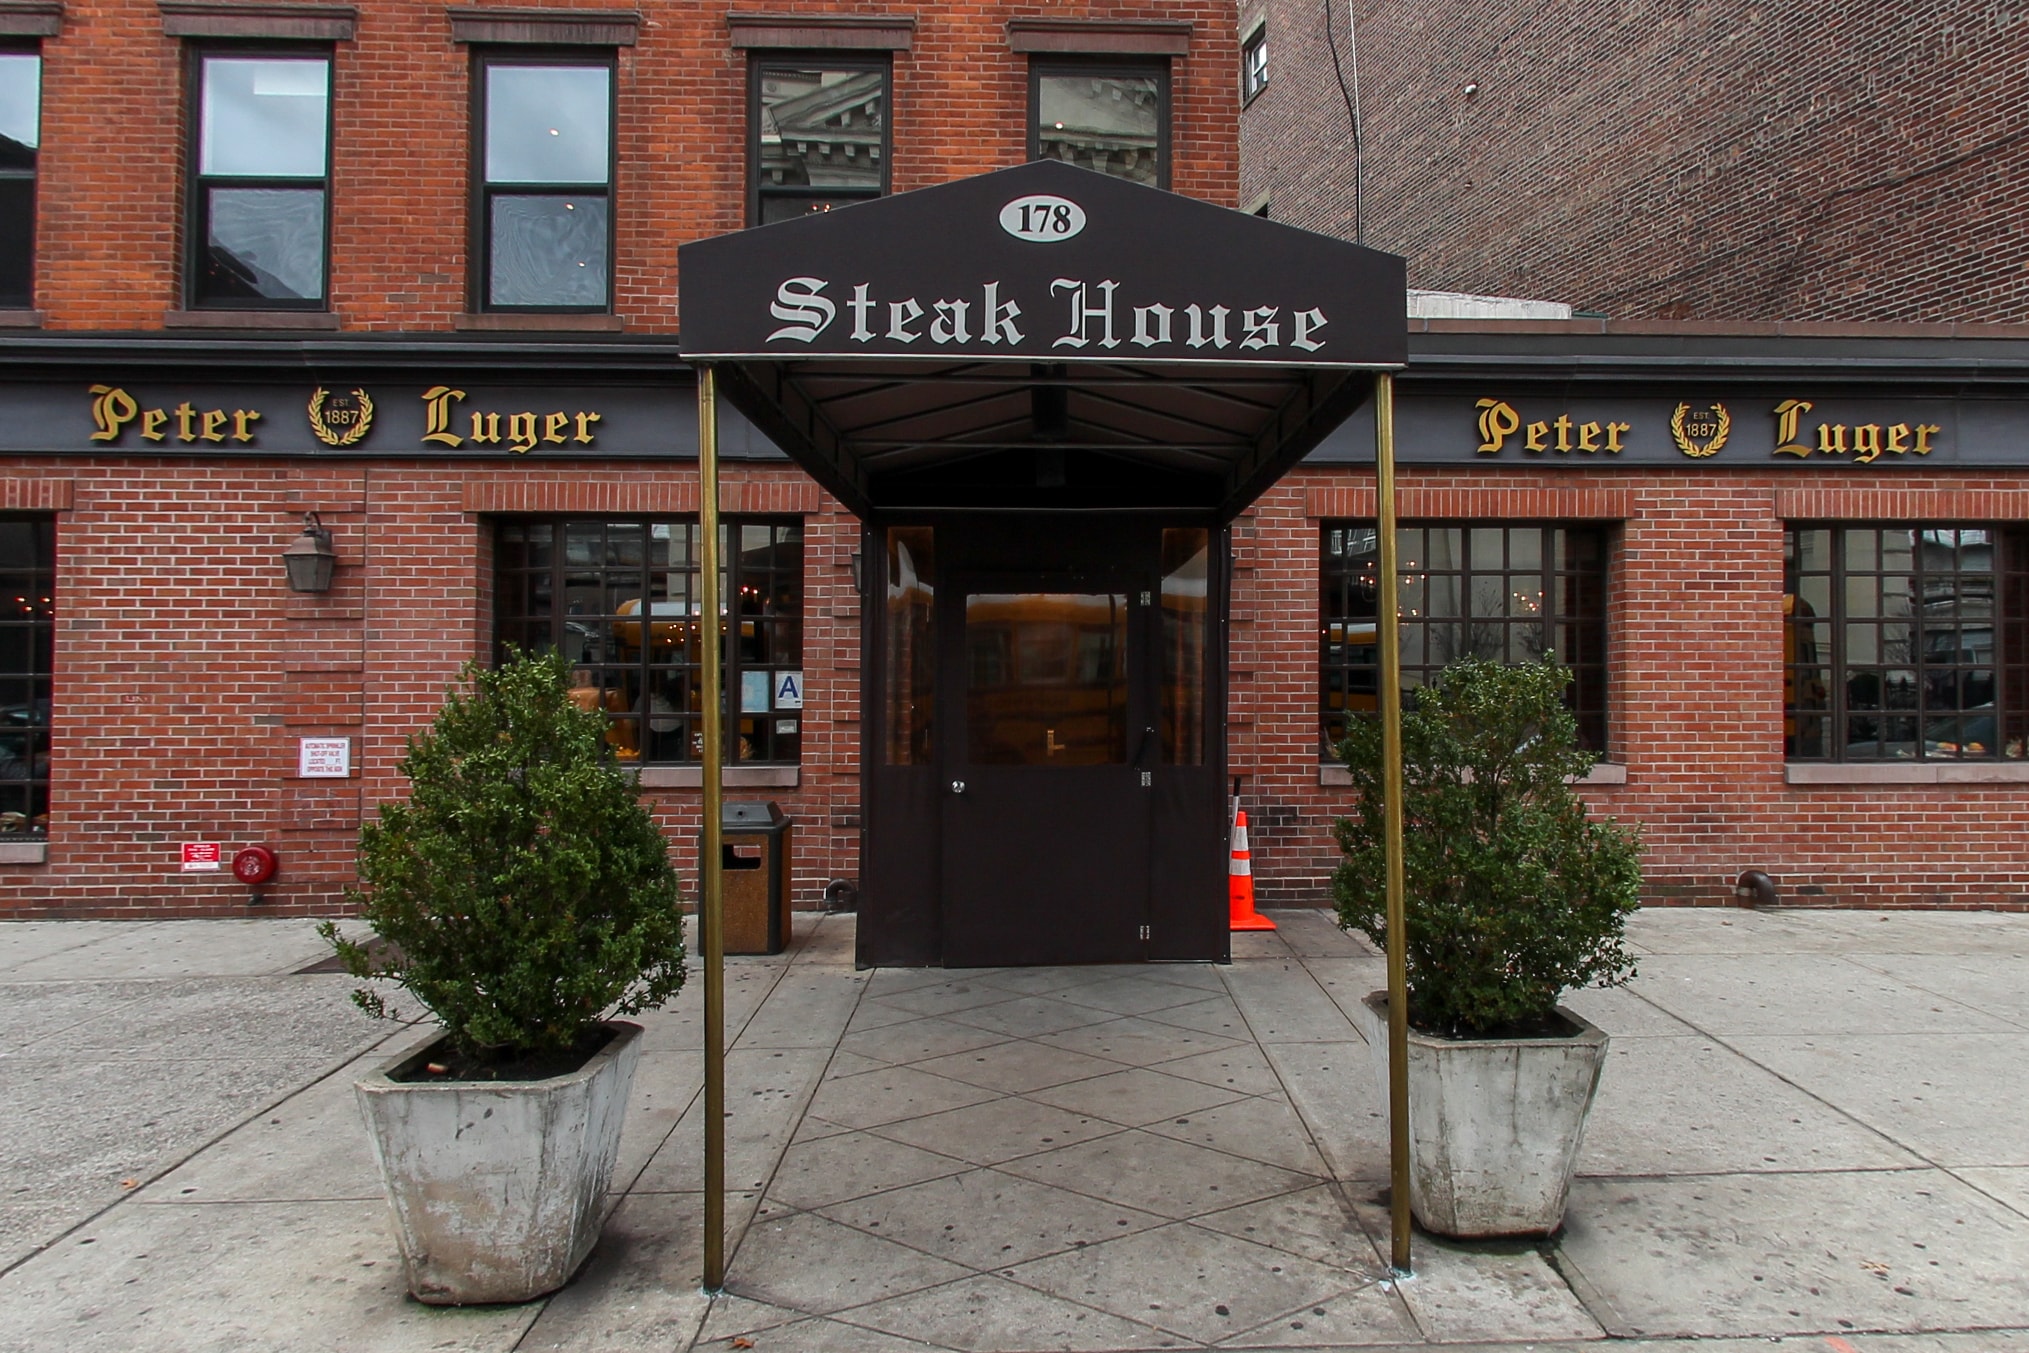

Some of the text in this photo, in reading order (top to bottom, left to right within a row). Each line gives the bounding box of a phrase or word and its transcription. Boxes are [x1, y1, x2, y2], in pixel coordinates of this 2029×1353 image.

[1017, 204, 1071, 234] 178
[765, 277, 1328, 351] Steak House
[89, 384, 261, 442] Peter
[325, 410, 359, 424] 1887
[421, 386, 601, 454] Luger
[1476, 398, 1631, 453] Peter
[1686, 423, 1718, 437] 1887
[1774, 399, 1941, 463] Luger
[778, 675, 799, 698] A
